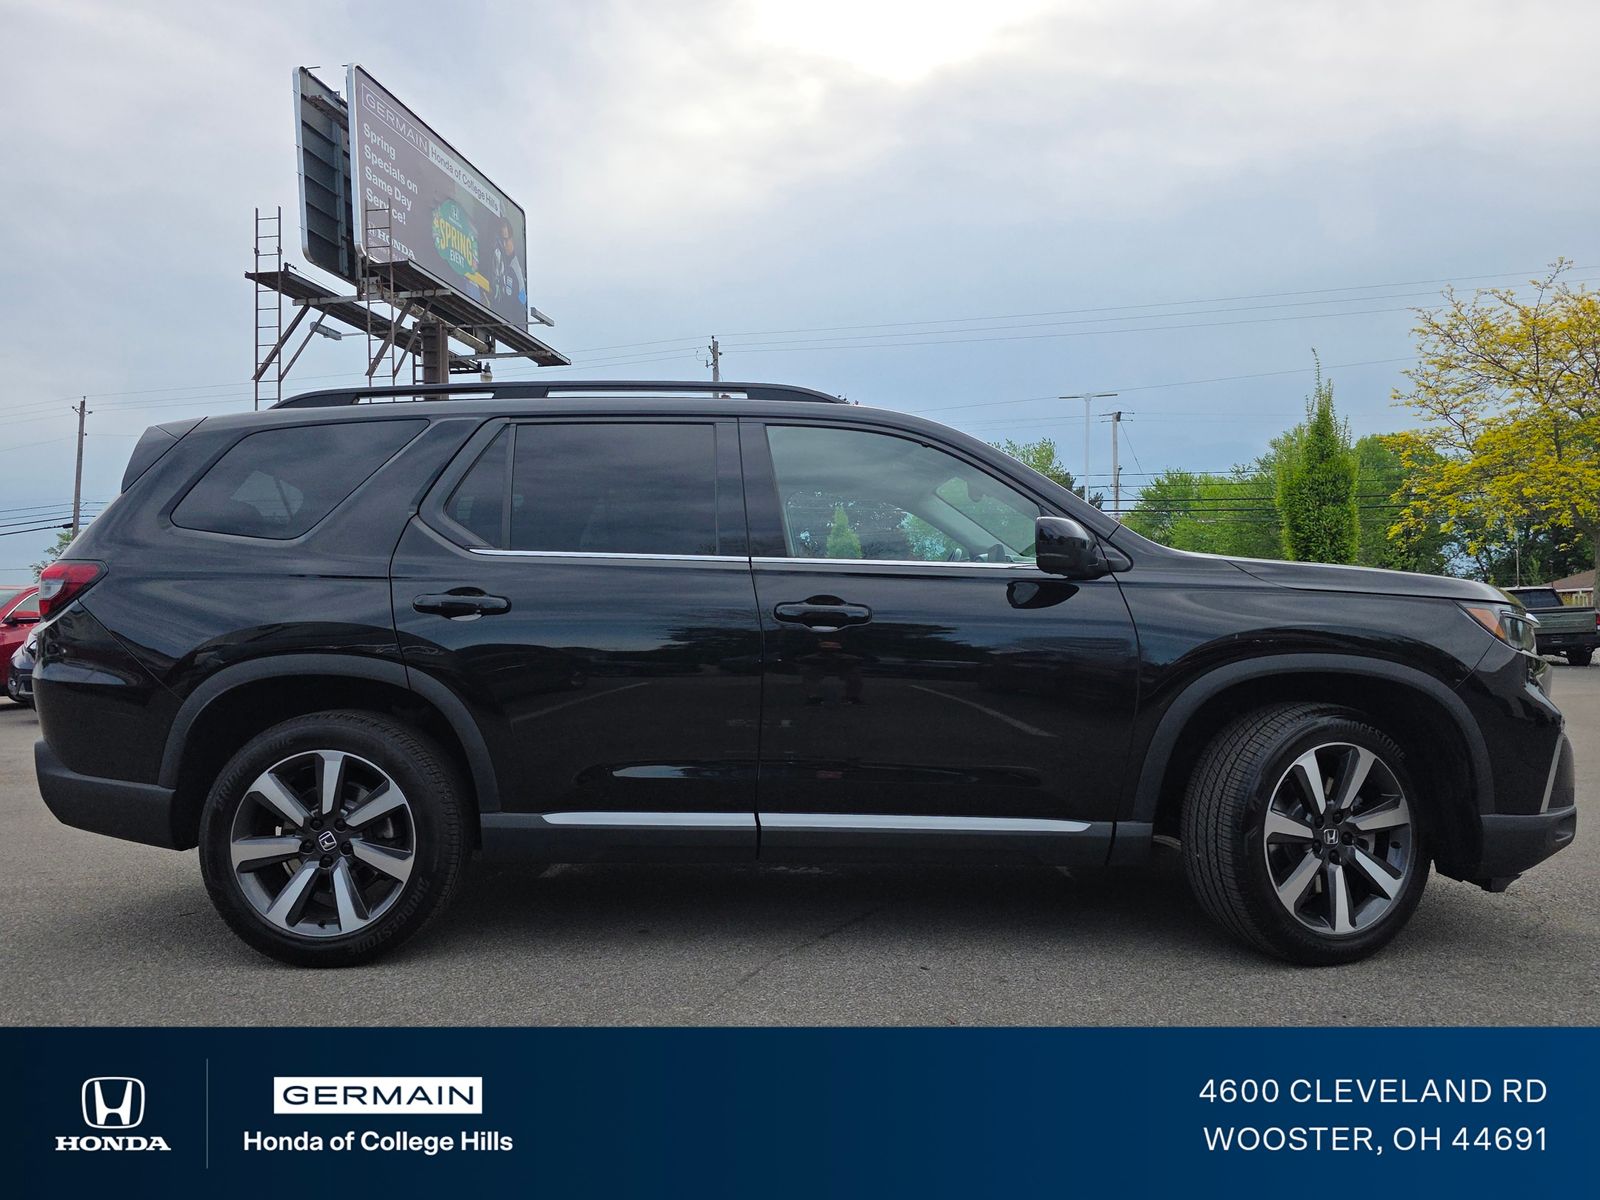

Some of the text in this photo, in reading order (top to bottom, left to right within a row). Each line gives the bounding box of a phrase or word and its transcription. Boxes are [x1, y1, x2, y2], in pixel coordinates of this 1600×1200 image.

[363, 122, 396, 161] Spring
[365, 93, 429, 154] GERMAIN
[364, 144, 418, 195] Specials on
[365, 166, 412, 211] Same Day
[431, 146, 455, 173] Honda
[462, 173, 486, 201] College
[486, 193, 500, 212] Hills
[366, 187, 406, 225] Servce!
[439, 219, 473, 266] SPRING
[449, 249, 465, 268] EVENT
